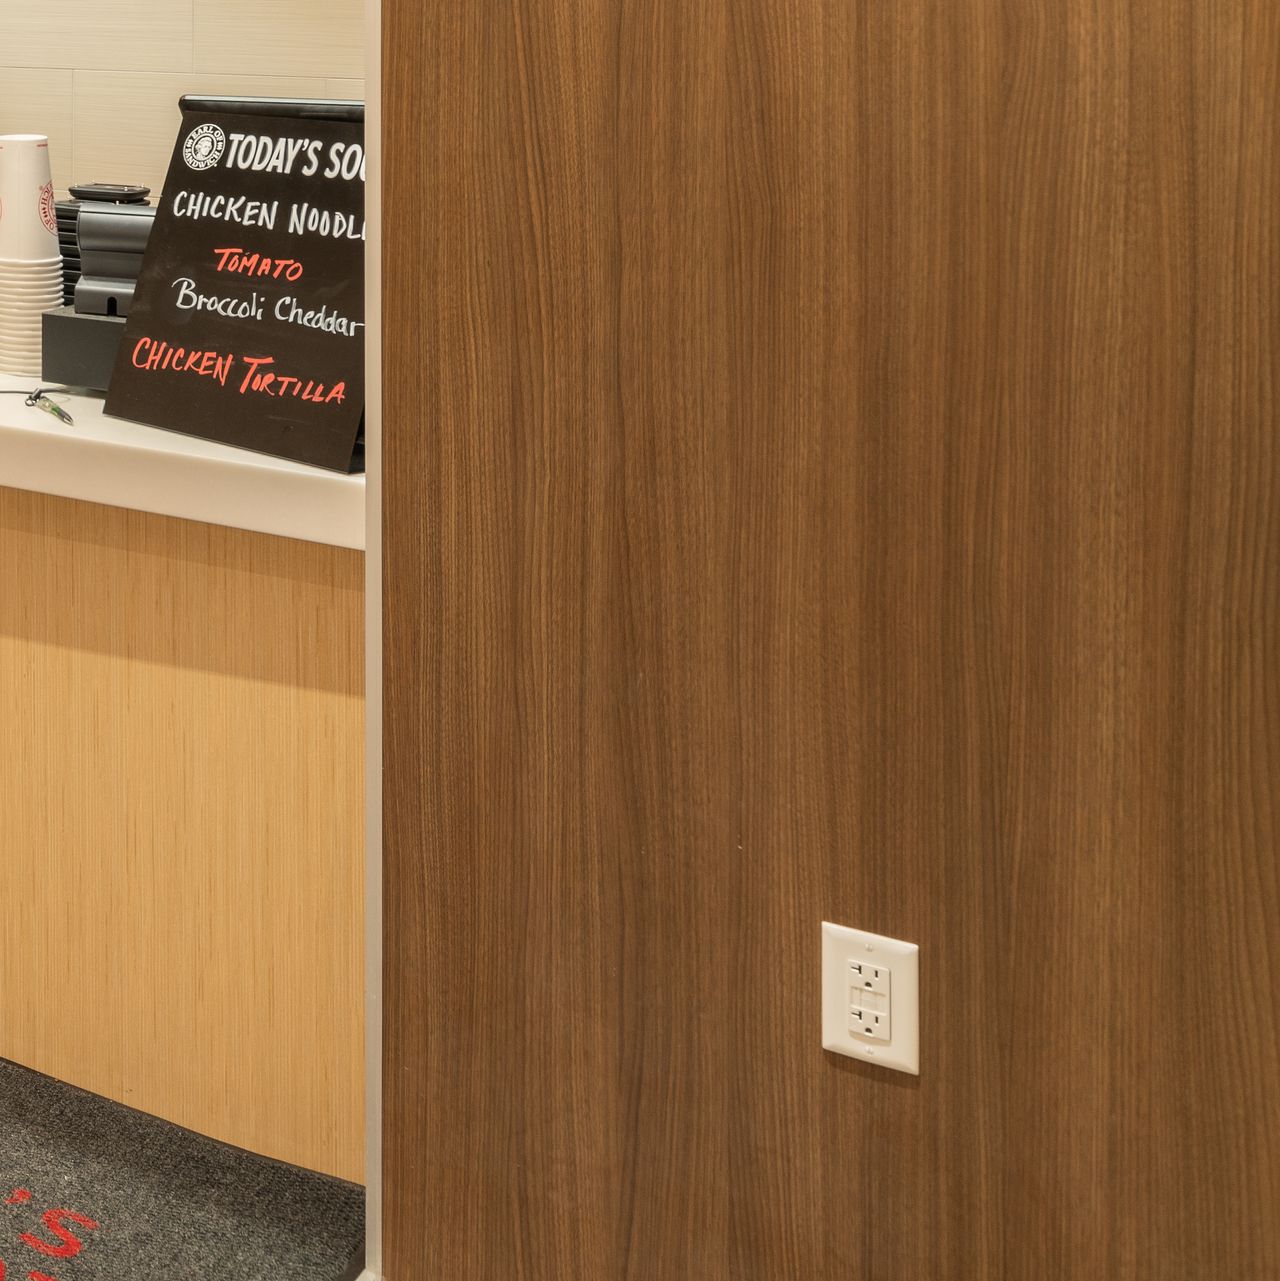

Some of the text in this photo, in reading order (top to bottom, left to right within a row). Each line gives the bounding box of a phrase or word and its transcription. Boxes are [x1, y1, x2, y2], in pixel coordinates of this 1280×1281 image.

[191, 126, 224, 141] EARL OF
[225, 133, 322, 177] TODAY'S
[185, 148, 221, 168] SANDWICH
[173, 191, 365, 241] CHICKEN NOODL
[214, 248, 303, 281] TOMATO
[172, 277, 365, 337] Broccoli Cheddar
[132, 337, 346, 404] CHICKEN TORTILLA
